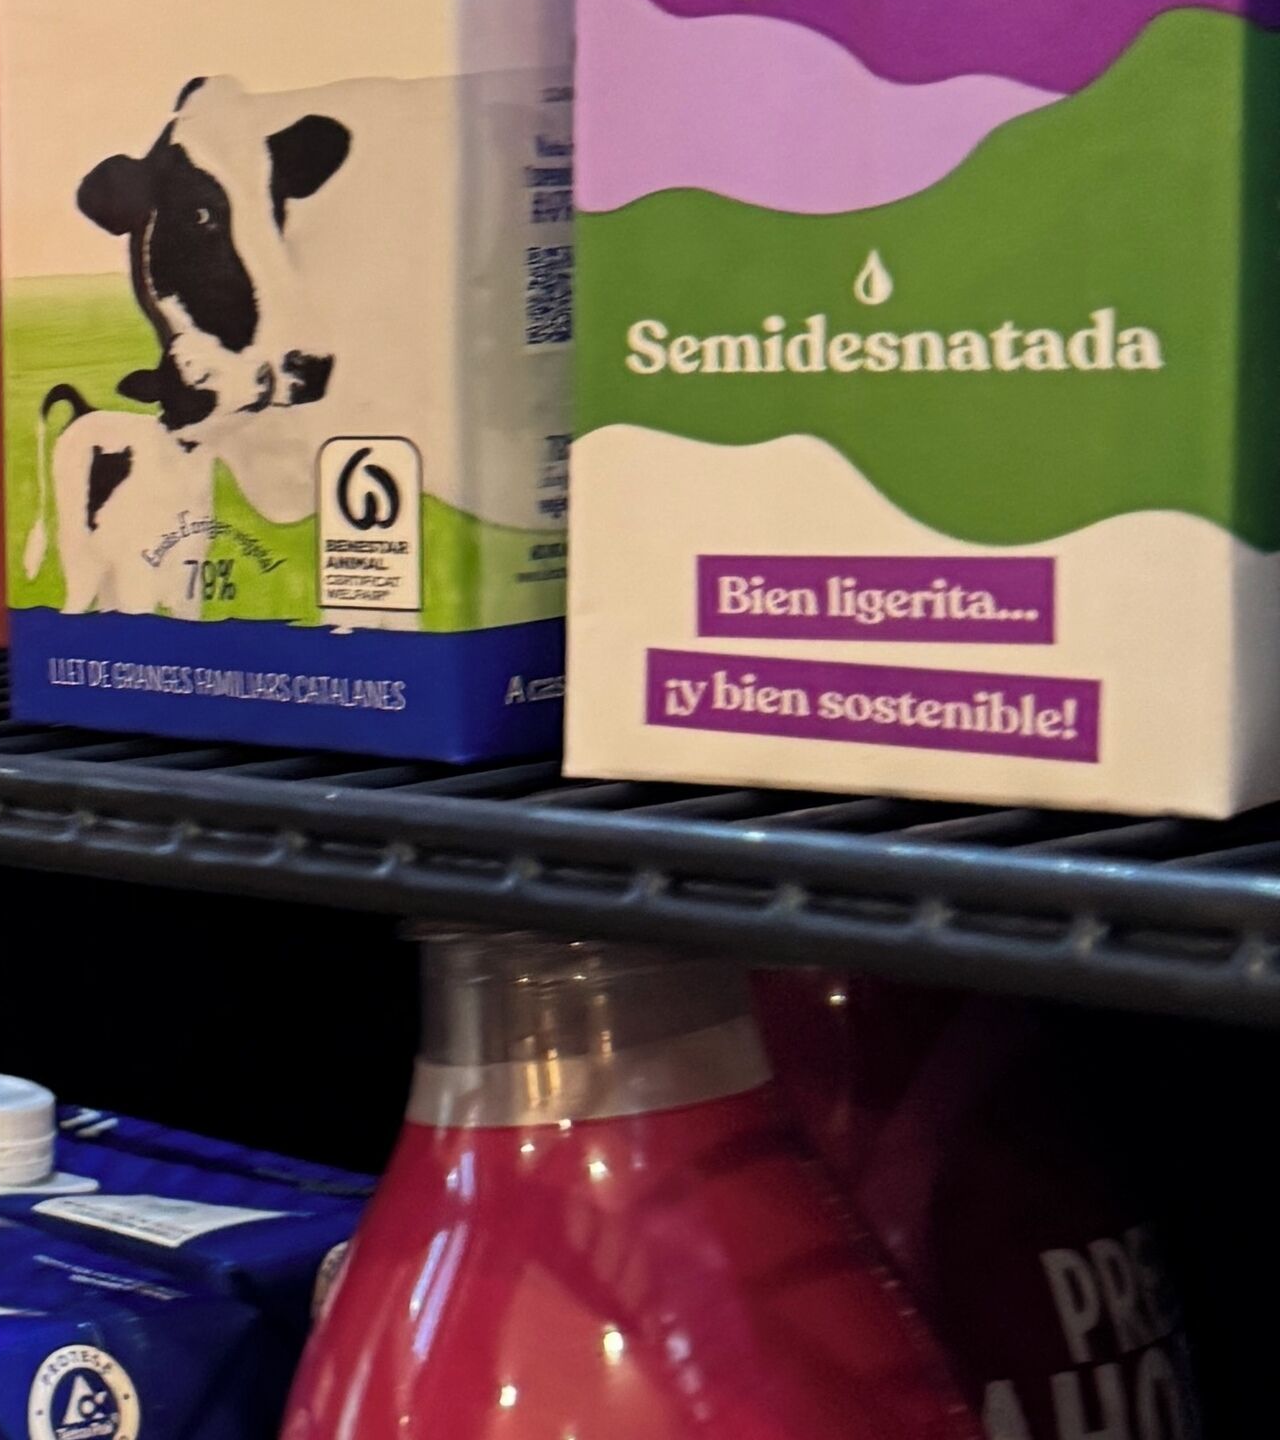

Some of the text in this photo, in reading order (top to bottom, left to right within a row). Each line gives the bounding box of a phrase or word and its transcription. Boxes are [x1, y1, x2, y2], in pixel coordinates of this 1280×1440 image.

[625, 307, 1165, 374] Semidesnatada
[716, 575, 1039, 624] Bien ligerita...
[48, 657, 86, 686] LLET
[87, 660, 112, 688] DE
[111, 662, 194, 694] GRANGES
[291, 674, 407, 711] CATALANES
[664, 670, 1079, 740] ¡y bien sostenible!
